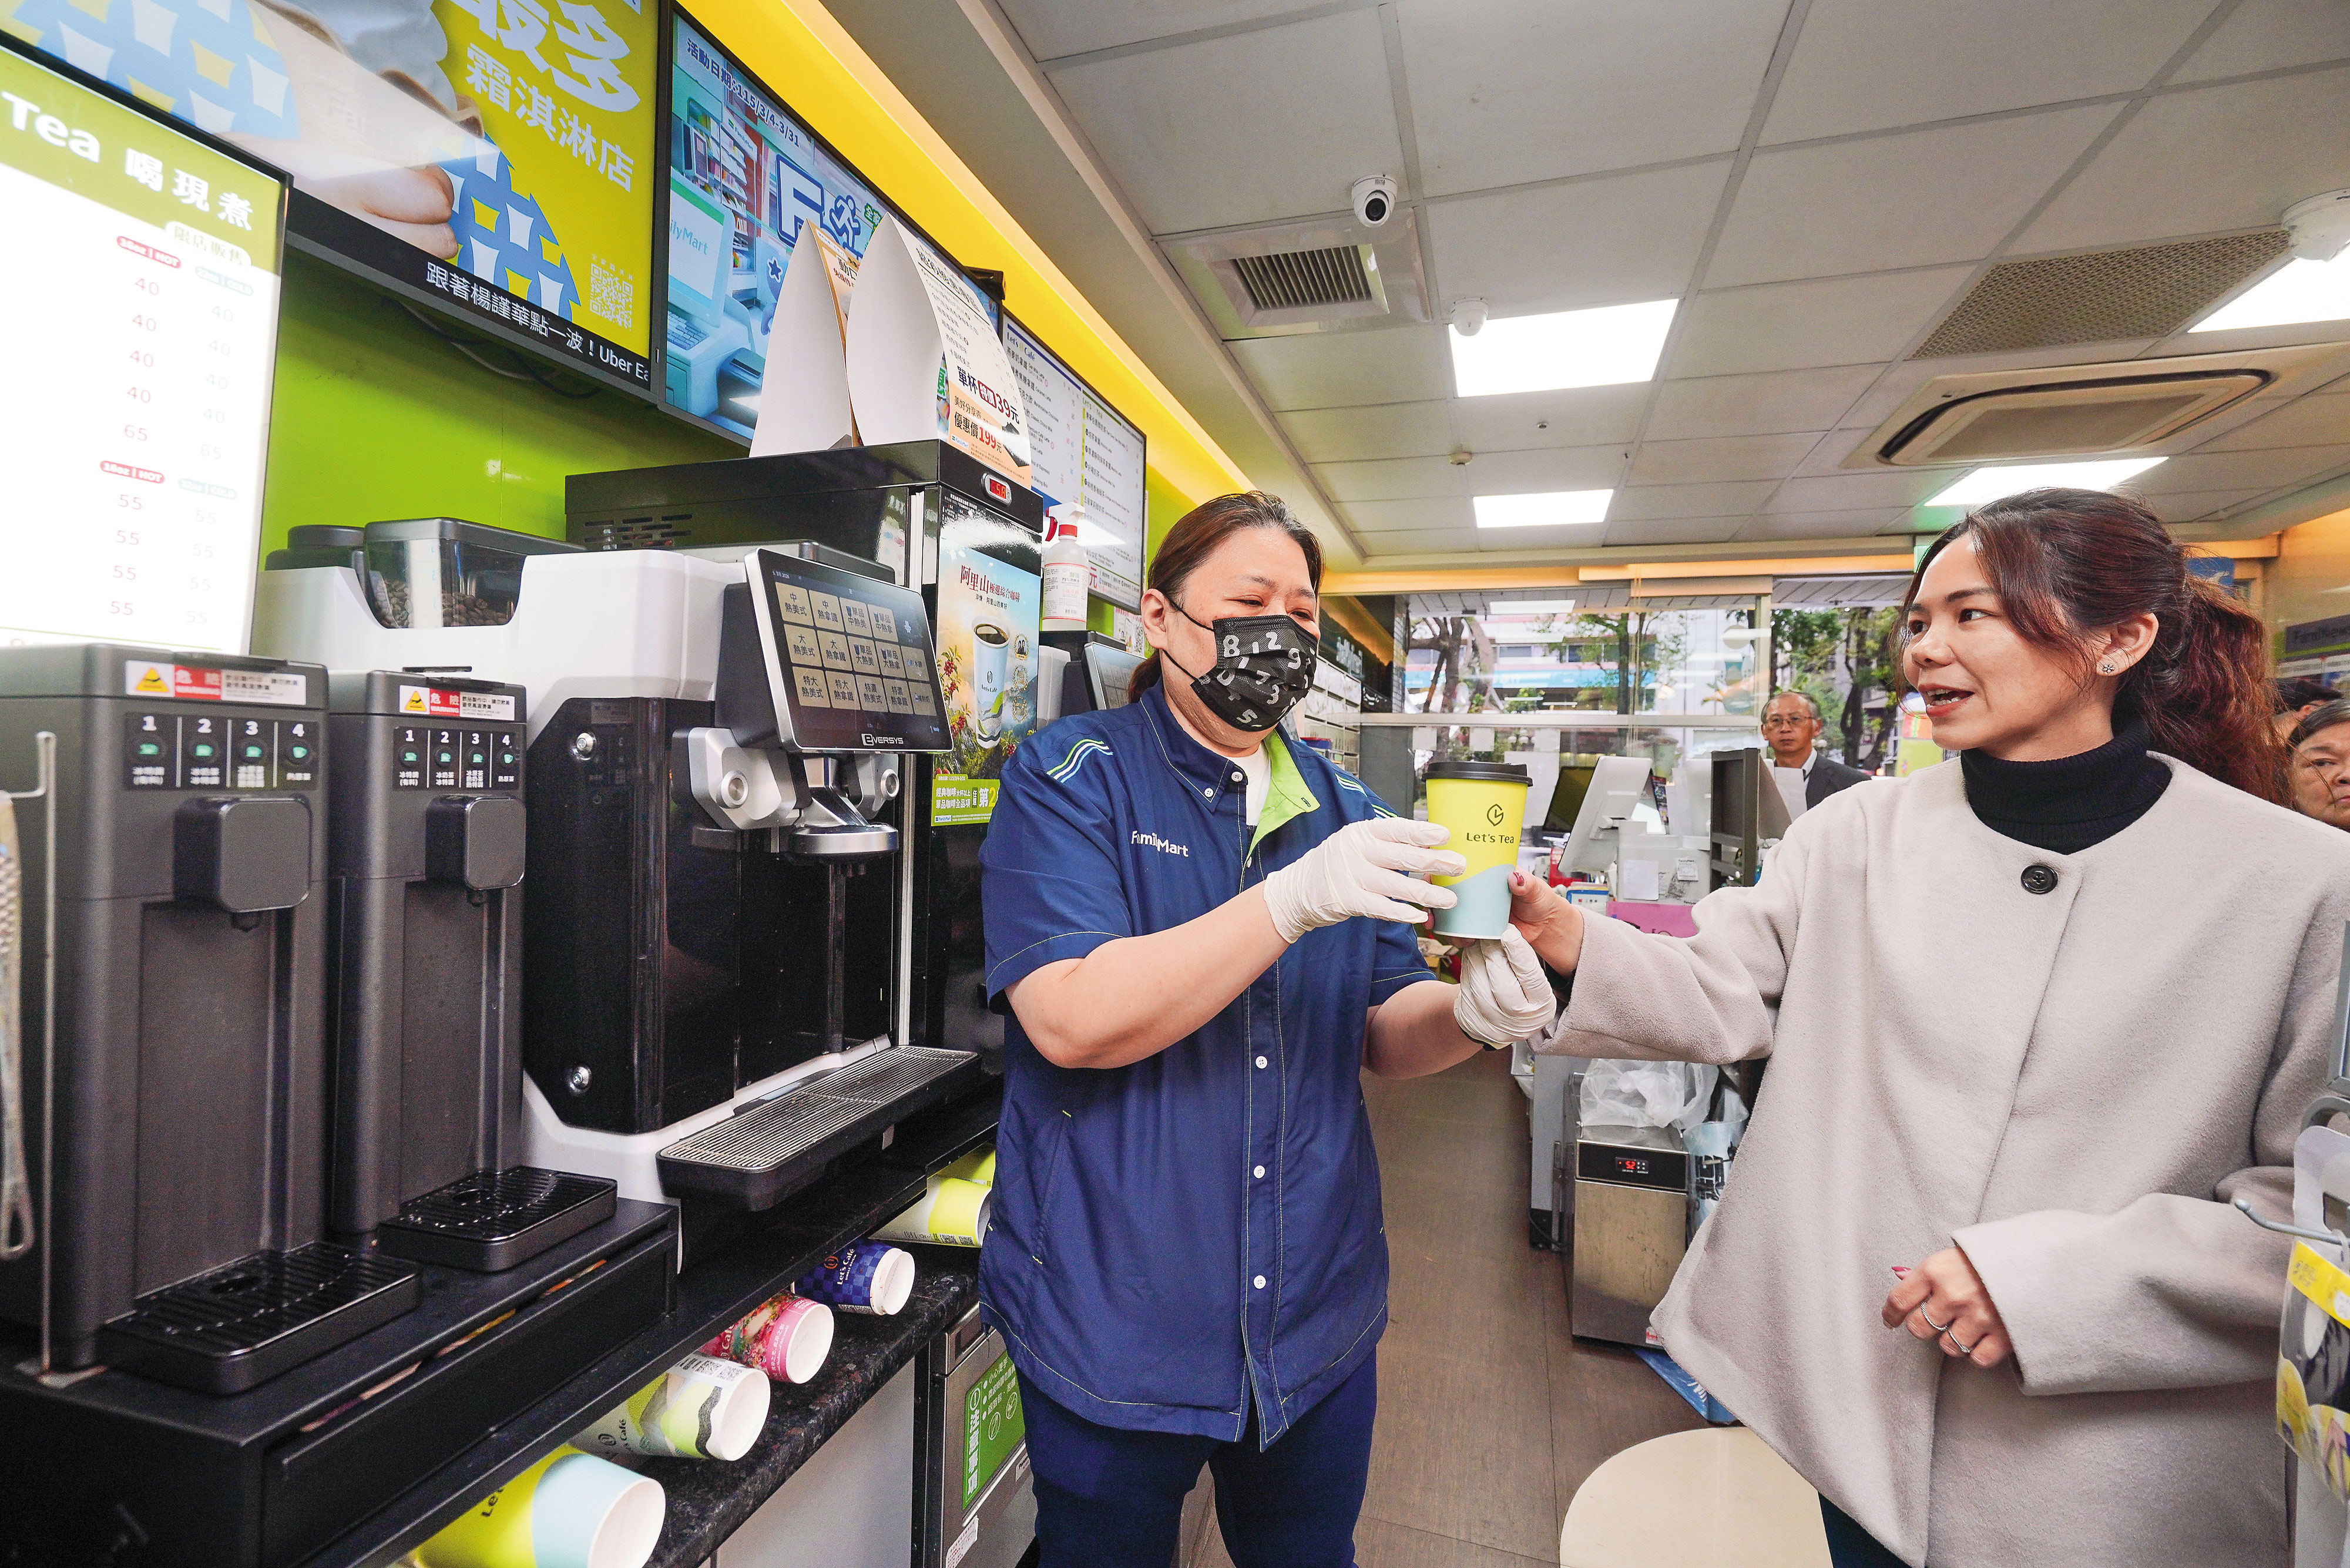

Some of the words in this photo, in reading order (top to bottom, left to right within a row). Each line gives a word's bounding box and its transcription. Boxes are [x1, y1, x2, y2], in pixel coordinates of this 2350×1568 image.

[466, 43, 634, 192] 霜淇淋店
[1, 90, 100, 163] Tea
[123, 147, 254, 230] 喝現煮
[135, 278, 160, 296] 40
[132, 314, 157, 332] 40
[129, 350, 154, 368] 40
[599, 348, 633, 374] Uber
[127, 387, 151, 404] 40
[124, 425, 148, 441] 65
[119, 494, 143, 510] 55
[116, 530, 139, 546] 55
[113, 565, 137, 581] 55
[1089, 566, 1097, 589] 元
[790, 592, 797, 603] 中
[822, 599, 829, 609] 中
[110, 601, 134, 616] 55
[785, 602, 807, 616] 熱美式
[852, 606, 865, 618] 單品
[817, 610, 838, 623] 熱拿鐵
[848, 617, 867, 629] 中熱美
[879, 613, 891, 623] 單品
[875, 623, 893, 634] 中熱拿
[798, 634, 806, 644] 大
[830, 639, 838, 650] 大
[1265, 631, 1282, 650] 2
[793, 644, 815, 657] 熱美式
[860, 644, 872, 655] 單品
[1223, 634, 1240, 658] 8
[825, 650, 846, 662] 熱拿鐵
[855, 655, 875, 666] 大熱美
[887, 649, 898, 660] 單品
[883, 660, 901, 670] 大熱拿
[803, 675, 818, 687] 特大
[835, 679, 850, 690] 特大
[864, 682, 877, 693] 特濃
[801, 686, 824, 699] 熱美式
[834, 690, 854, 701] 熱拿鐵
[891, 685, 904, 696] 特濃
[1266, 684, 1280, 705] 3
[864, 693, 882, 704] 熱美式
[891, 696, 908, 706] 熱拿鐵
[142, 716, 157, 731] 1
[197, 718, 212, 734] 2
[246, 721, 258, 736] 3
[292, 723, 305, 737] 4
[405, 730, 414, 742] 1
[440, 731, 449, 743] 2
[471, 733, 479, 744] 3
[502, 735, 510, 746] 4
[935, 787, 971, 797] 經典咖啡大杯以上
[935, 798, 971, 810] 單品咖啡全品項
[1466, 832, 1496, 843] Let's
[1499, 834, 1514, 844] Tea
[837, 1266, 847, 1285] Let's
[842, 1248, 855, 1265] Café
[619, 1419, 627, 1441] Café
[966, 1408, 980, 1496] 注意事項
